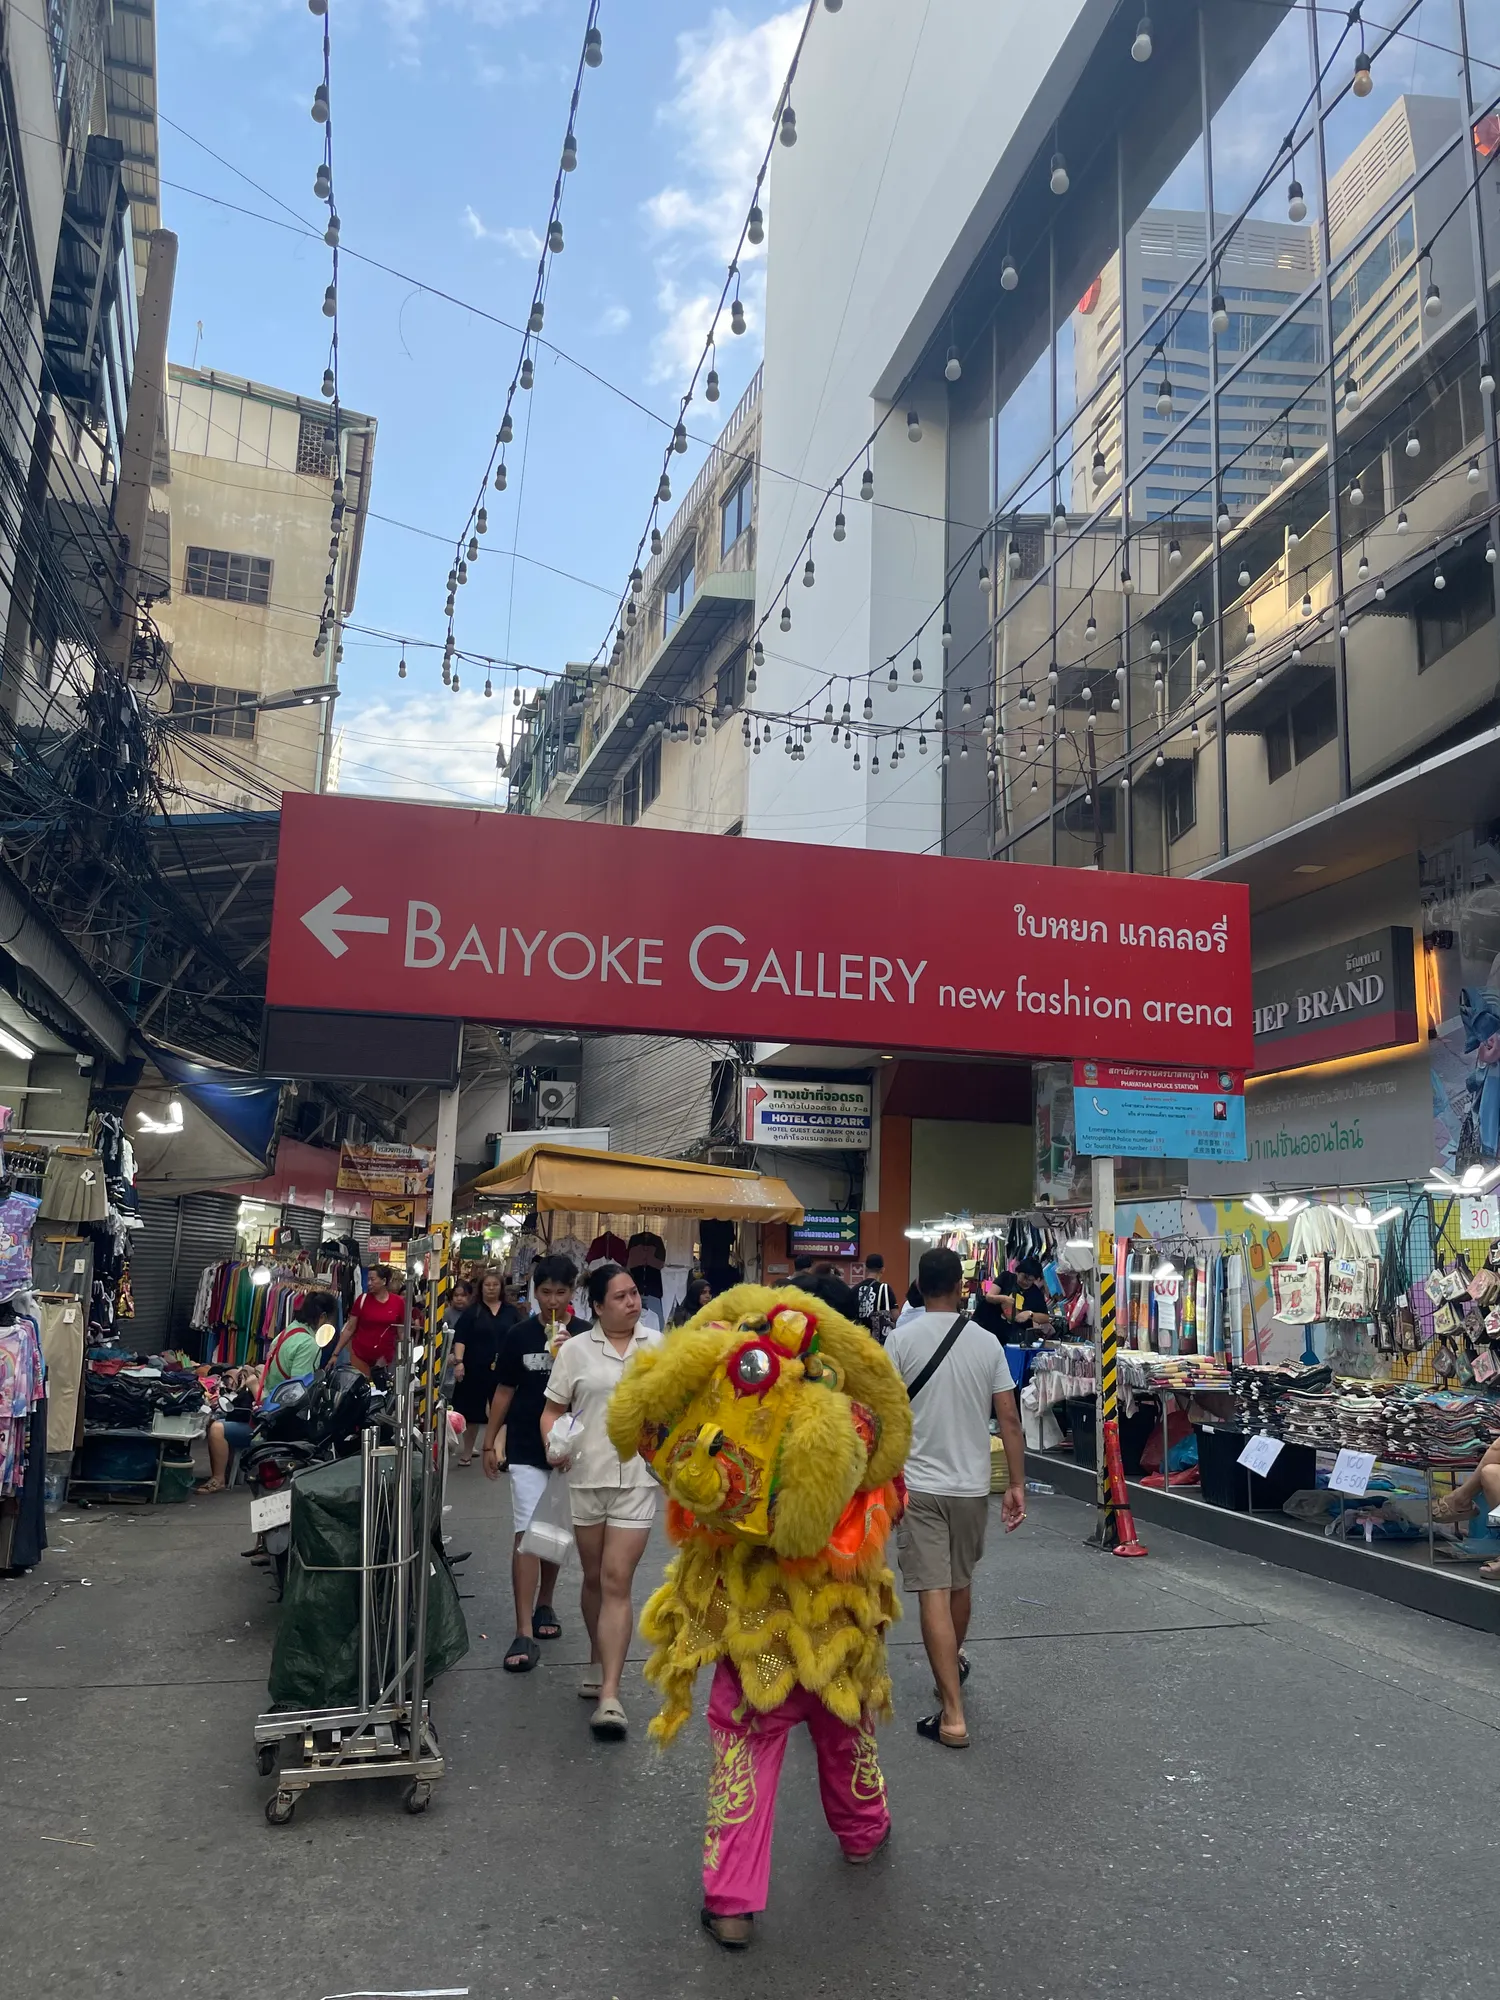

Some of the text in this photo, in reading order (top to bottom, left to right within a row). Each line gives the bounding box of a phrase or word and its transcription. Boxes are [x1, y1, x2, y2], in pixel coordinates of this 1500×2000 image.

[1013, 904, 1229, 953] ใบหยก แกลลอรี่
[403, 900, 1233, 1028] BAIYOKE GALLERY new fashion arena
[1297, 974, 1384, 1024] BRAND
[1120, 1080, 1152, 1088] PHAYATHAI
[773, 1086, 864, 1103] ทางเข้าที่จอดรถ
[771, 1113, 864, 1127] HOTEL CAR PARK
[1088, 1126, 1116, 1134] Emergency
[1471, 1208, 1489, 1229] 30
